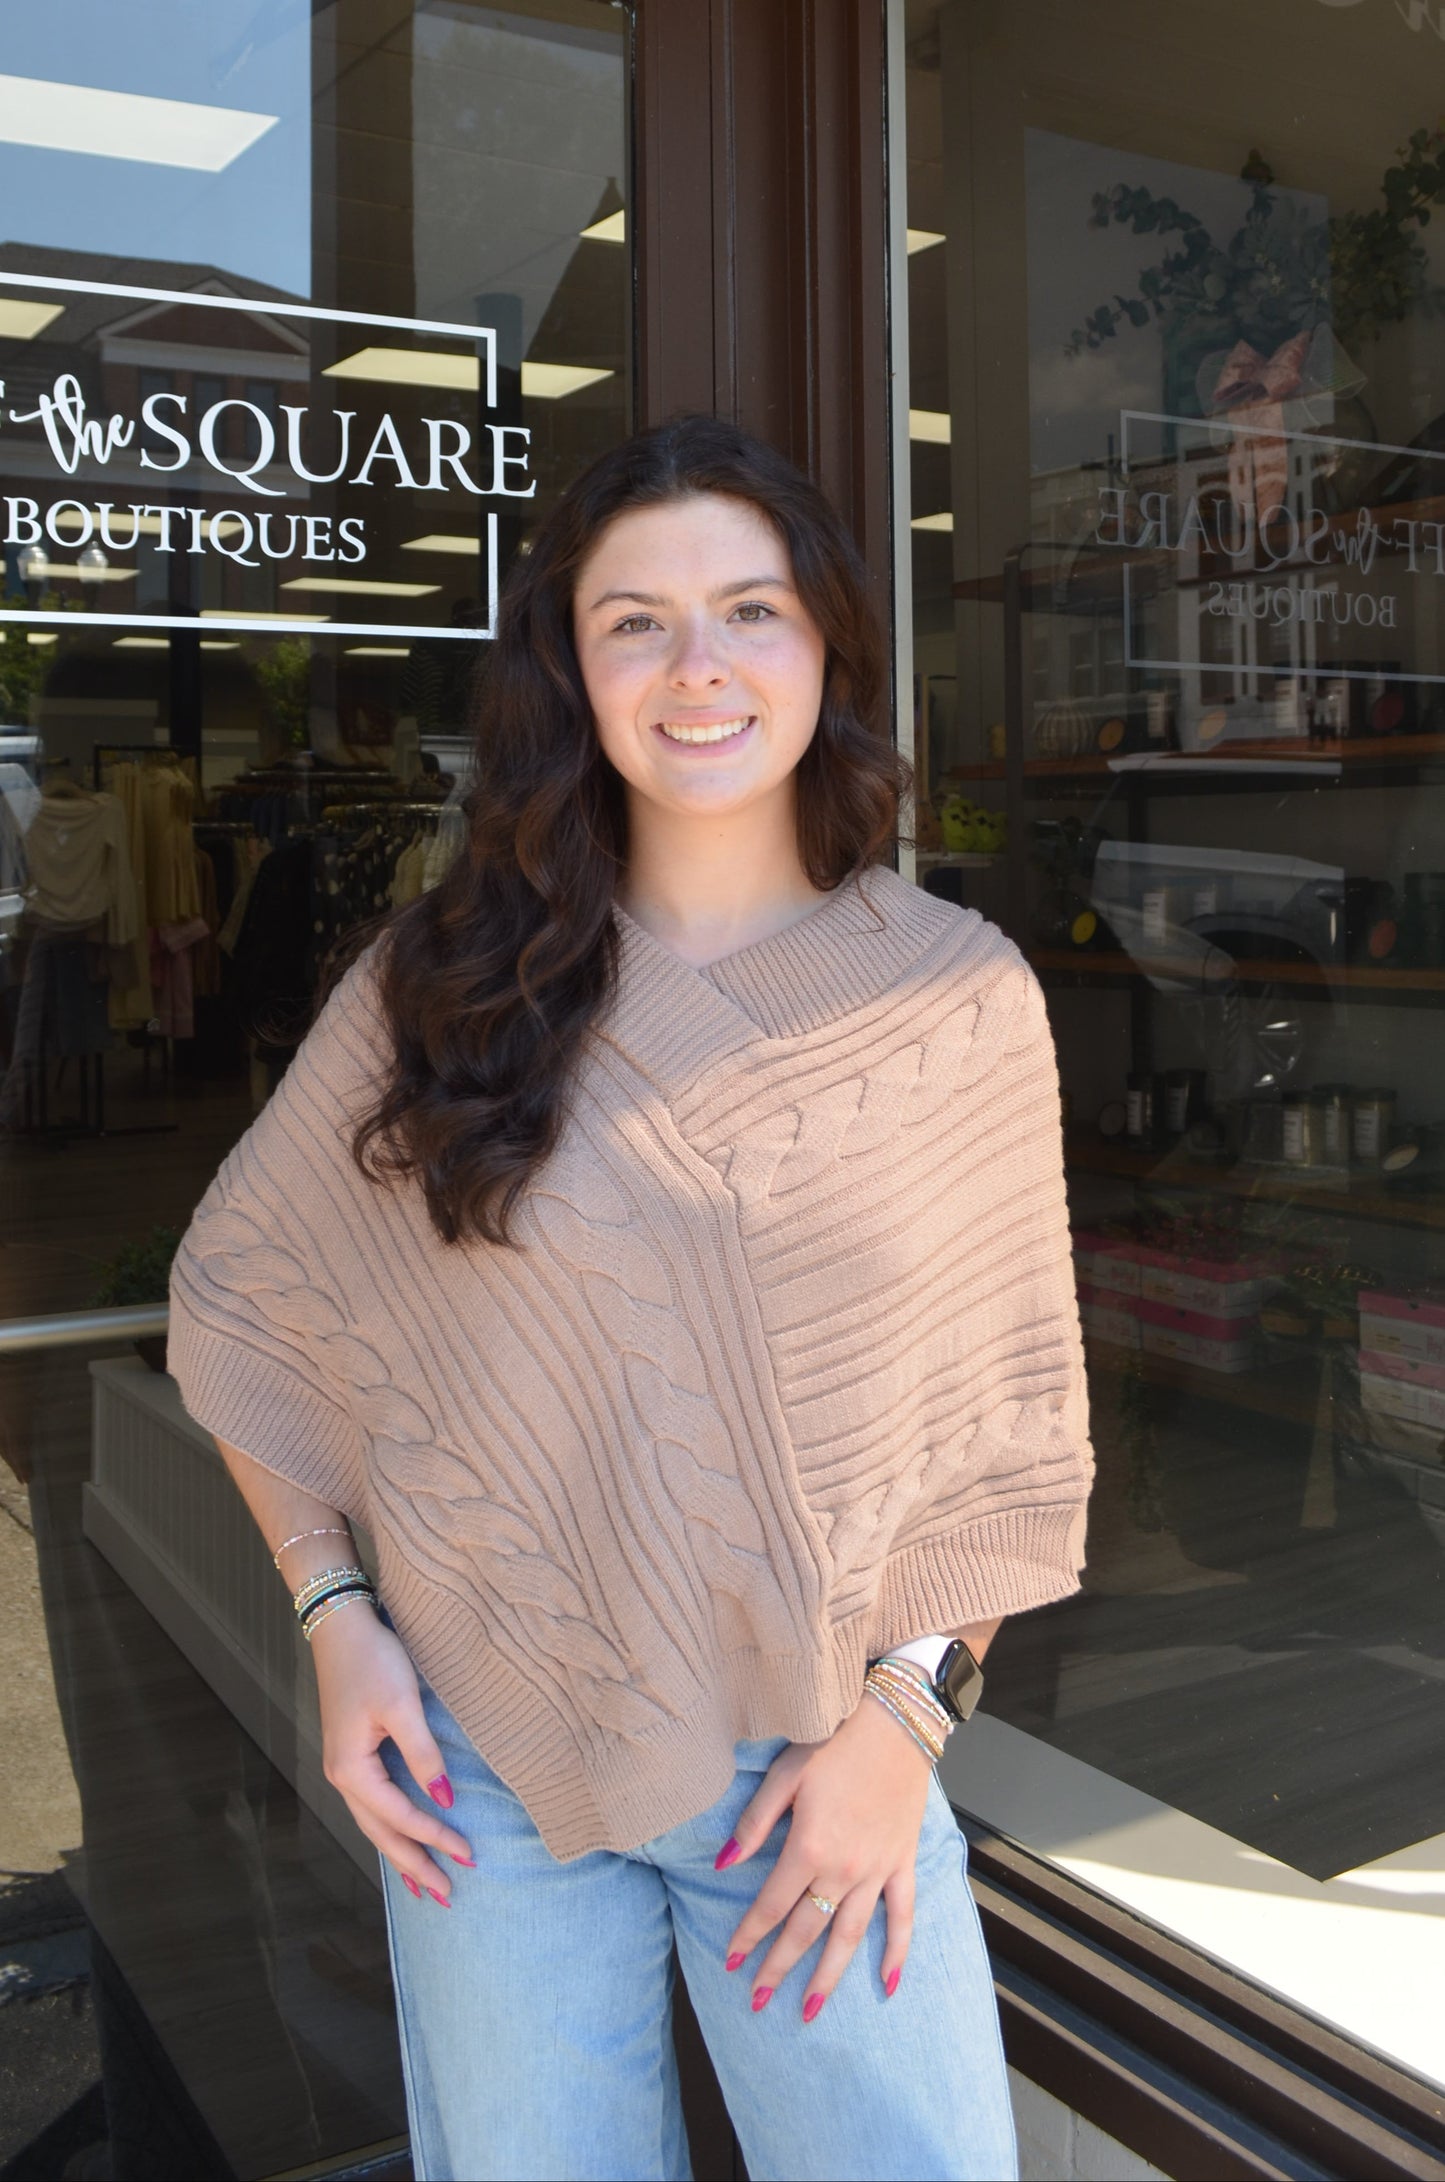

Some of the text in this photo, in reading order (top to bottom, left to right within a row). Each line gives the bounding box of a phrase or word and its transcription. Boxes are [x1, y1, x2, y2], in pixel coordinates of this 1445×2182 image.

[9, 373, 136, 474] the
[140, 393, 537, 498] SQUARE
[3, 496, 367, 567] BOUTIQUES
